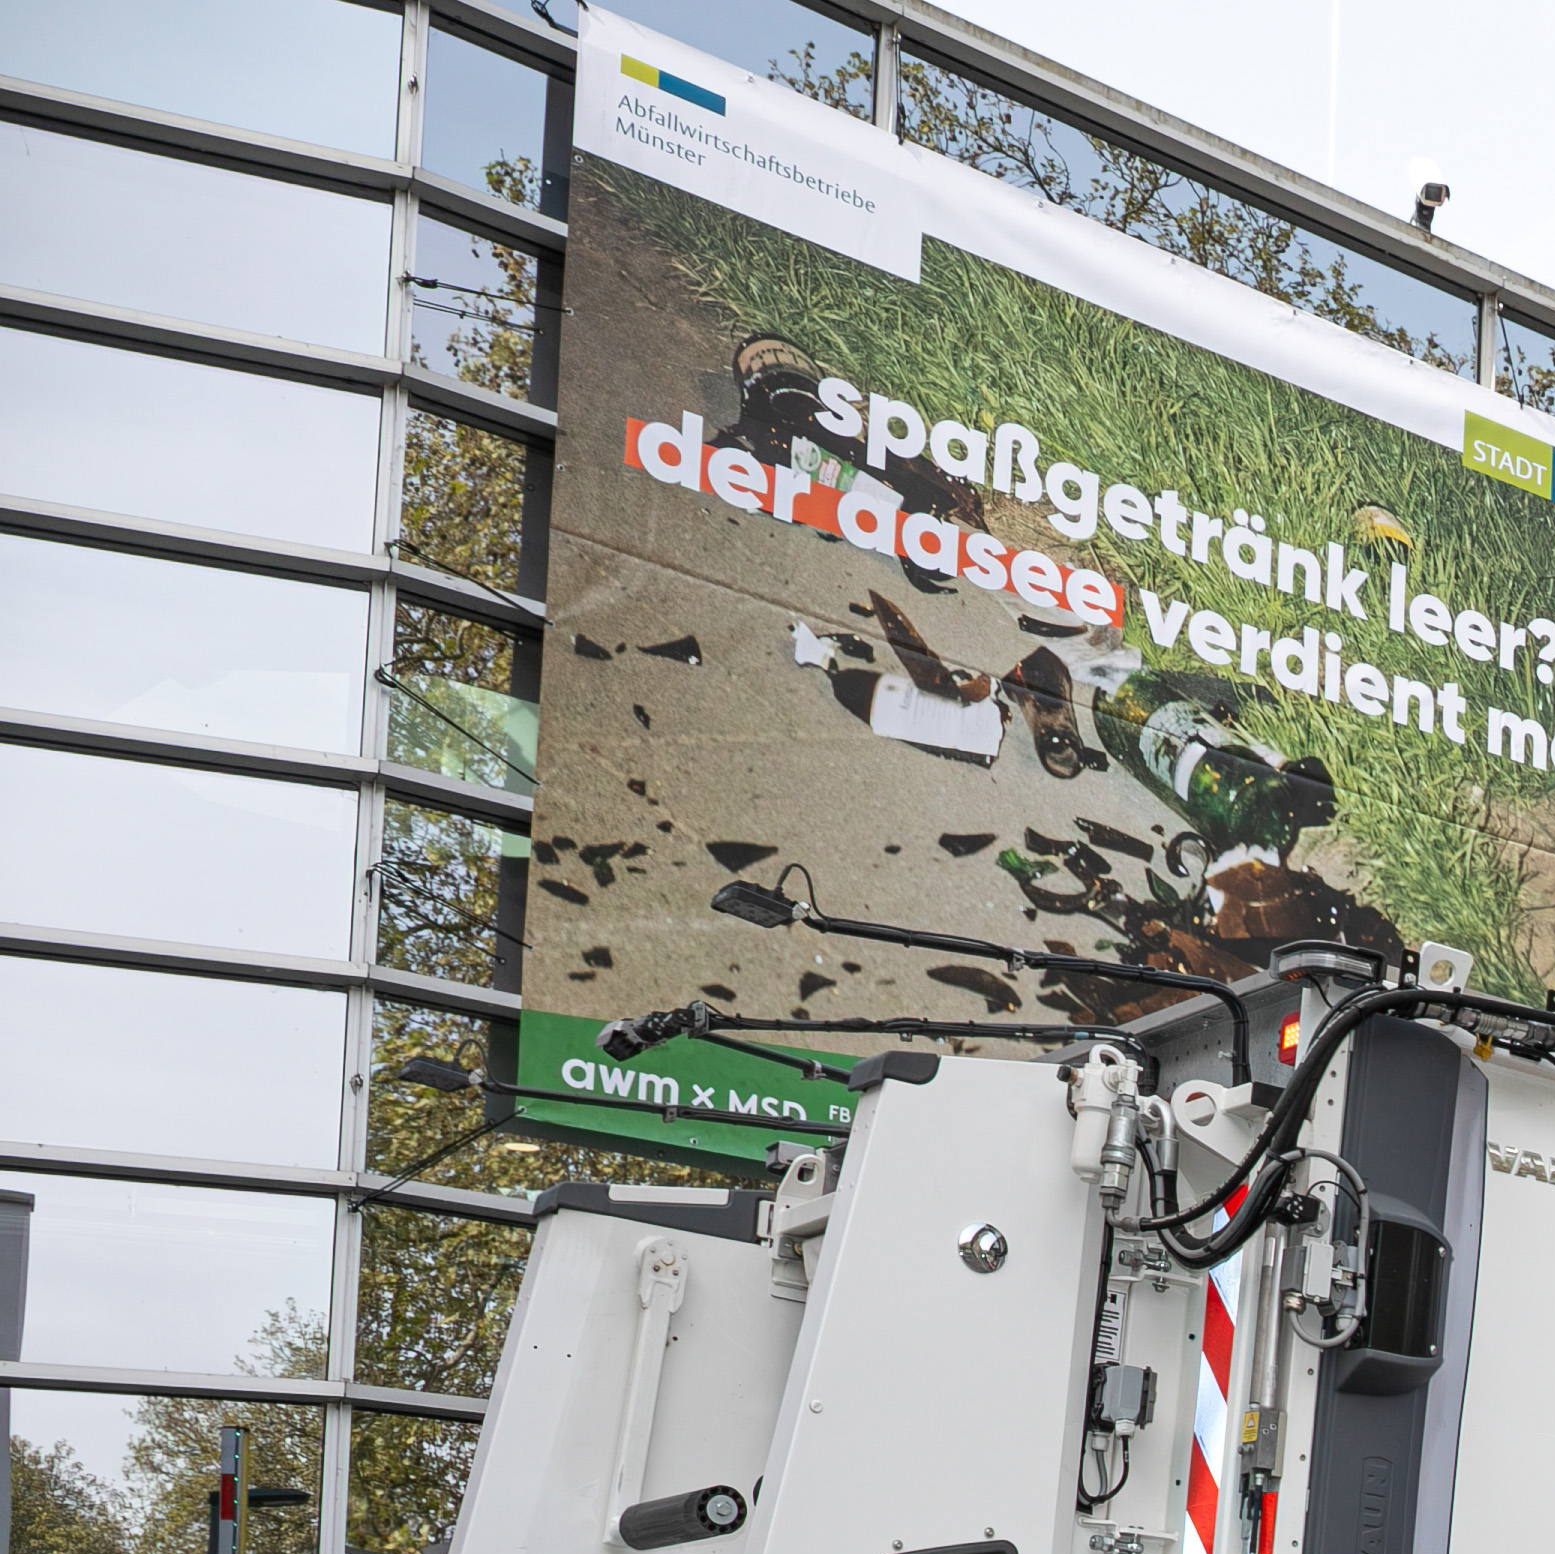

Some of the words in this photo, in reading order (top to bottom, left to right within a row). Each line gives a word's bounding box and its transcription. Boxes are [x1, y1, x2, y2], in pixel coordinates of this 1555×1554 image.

[614, 117, 706, 168] Münster
[617, 93, 876, 214] Abfallwirtschaftsbetriebe
[814, 376, 1367, 621] spaßgetränk
[1472, 438, 1548, 487] STADT
[637, 410, 811, 523] der
[837, 490, 1117, 625] aasee
[1140, 588, 1466, 744] verdient
[561, 1058, 680, 1106] awm
